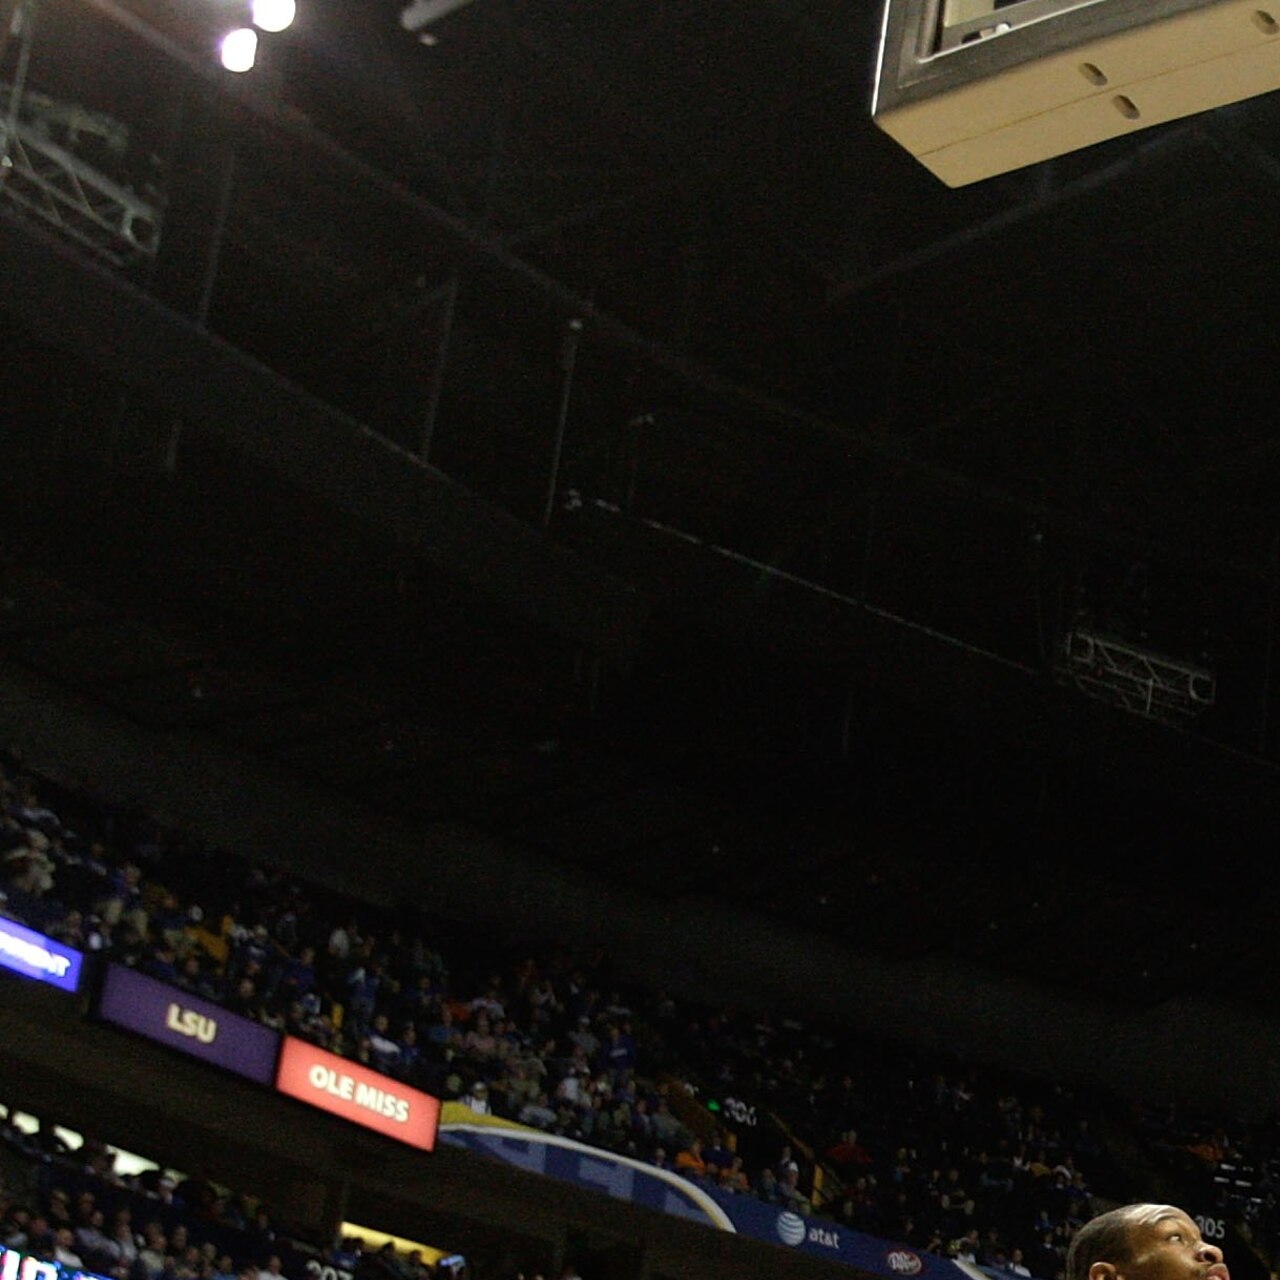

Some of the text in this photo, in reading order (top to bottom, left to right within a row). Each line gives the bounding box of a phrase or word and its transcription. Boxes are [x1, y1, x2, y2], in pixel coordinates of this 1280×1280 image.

[166, 1004, 217, 1044] LSU
[308, 1064, 409, 1122] OLE MISS
